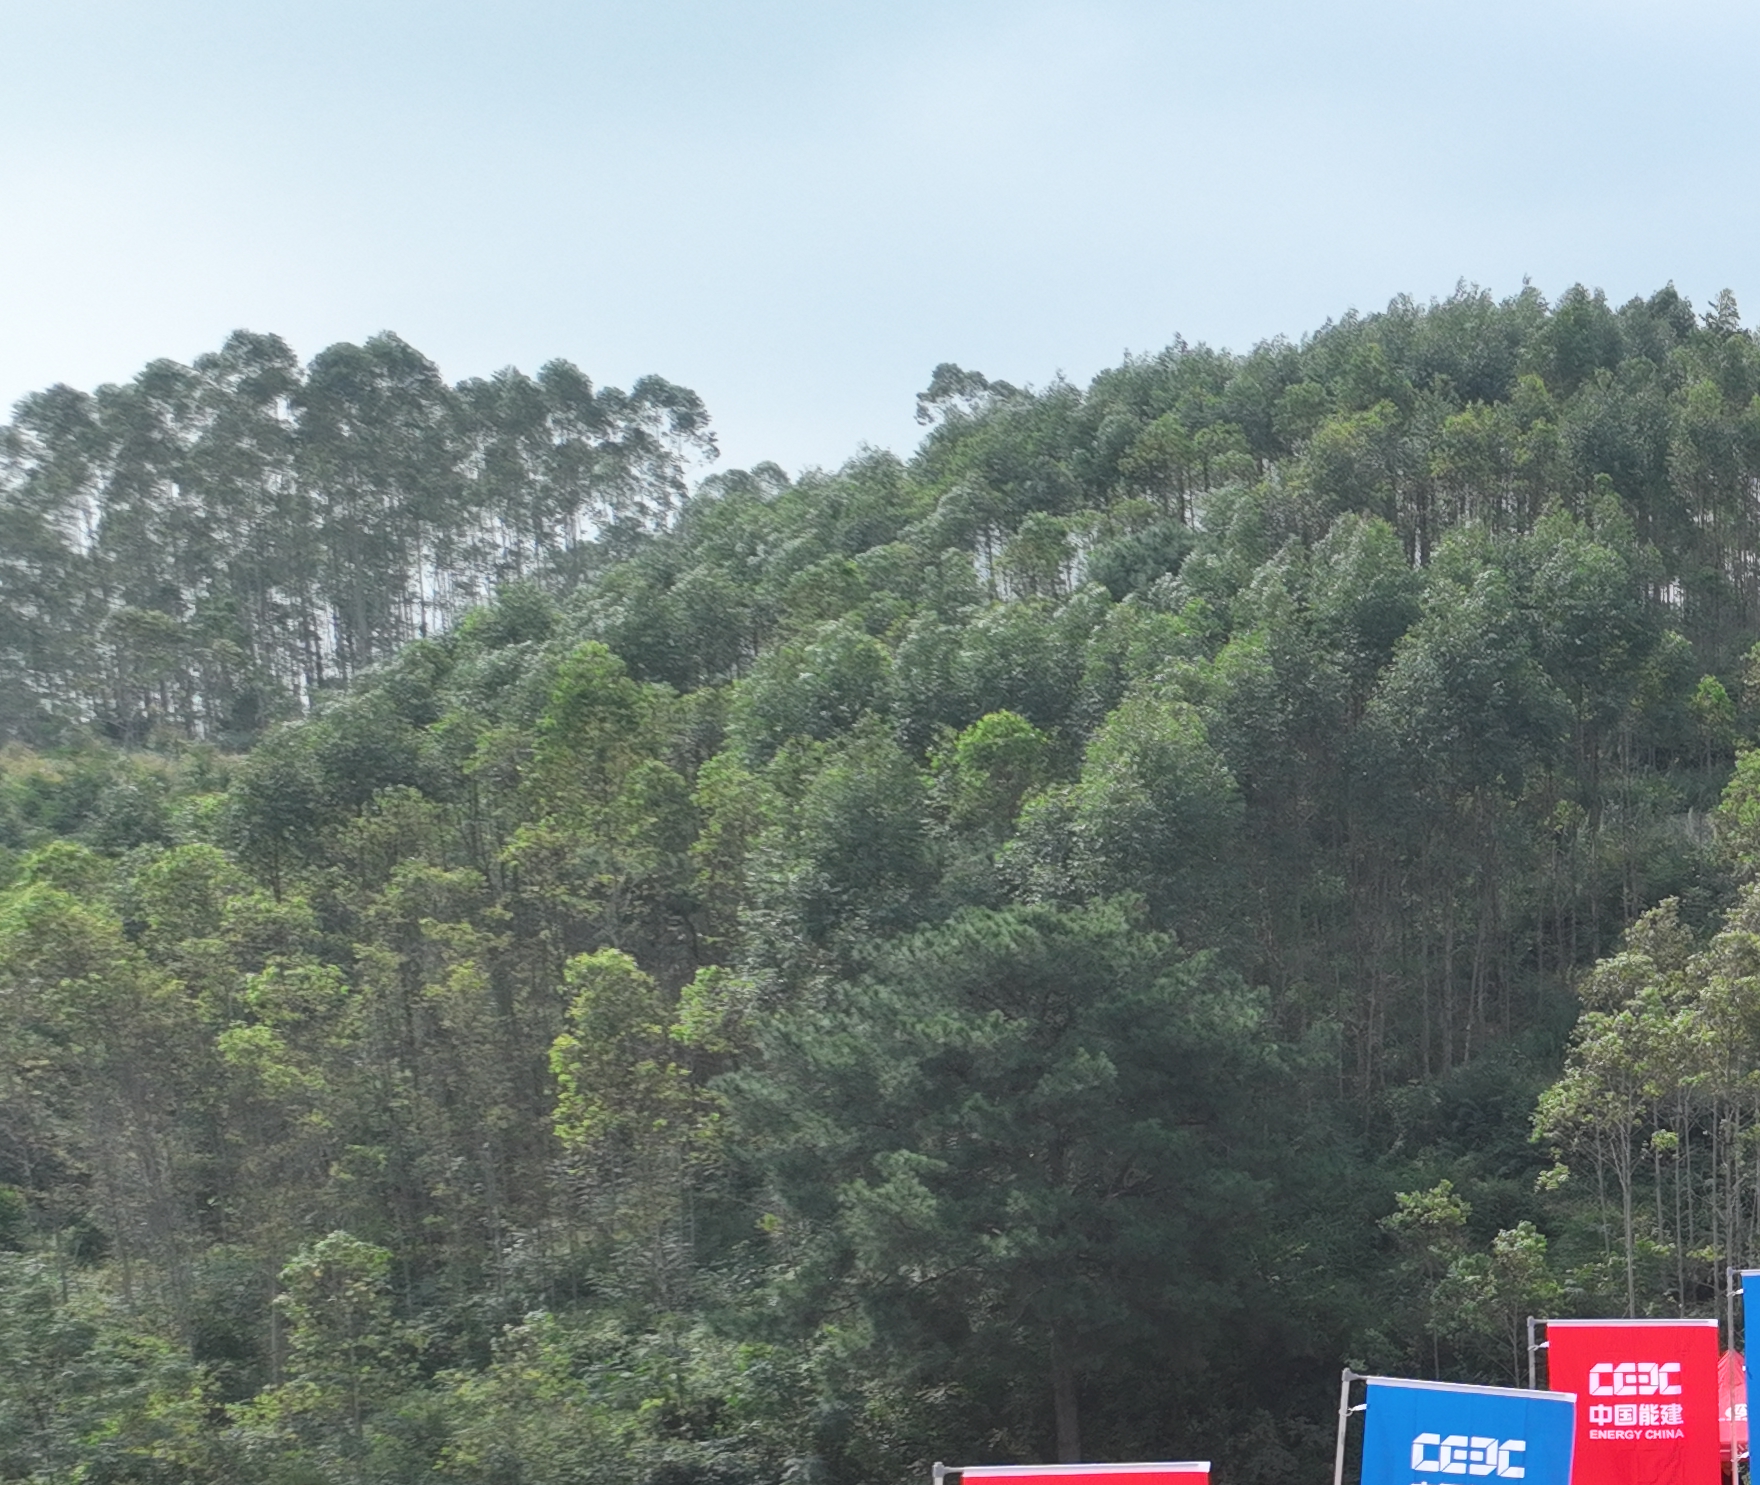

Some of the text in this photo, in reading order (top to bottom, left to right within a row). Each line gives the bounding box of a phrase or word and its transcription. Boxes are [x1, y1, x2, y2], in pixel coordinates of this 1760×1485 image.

[1589, 1403, 1684, 1427] 中国能建
[1589, 1429, 1684, 1440] ENERGY CHINA
